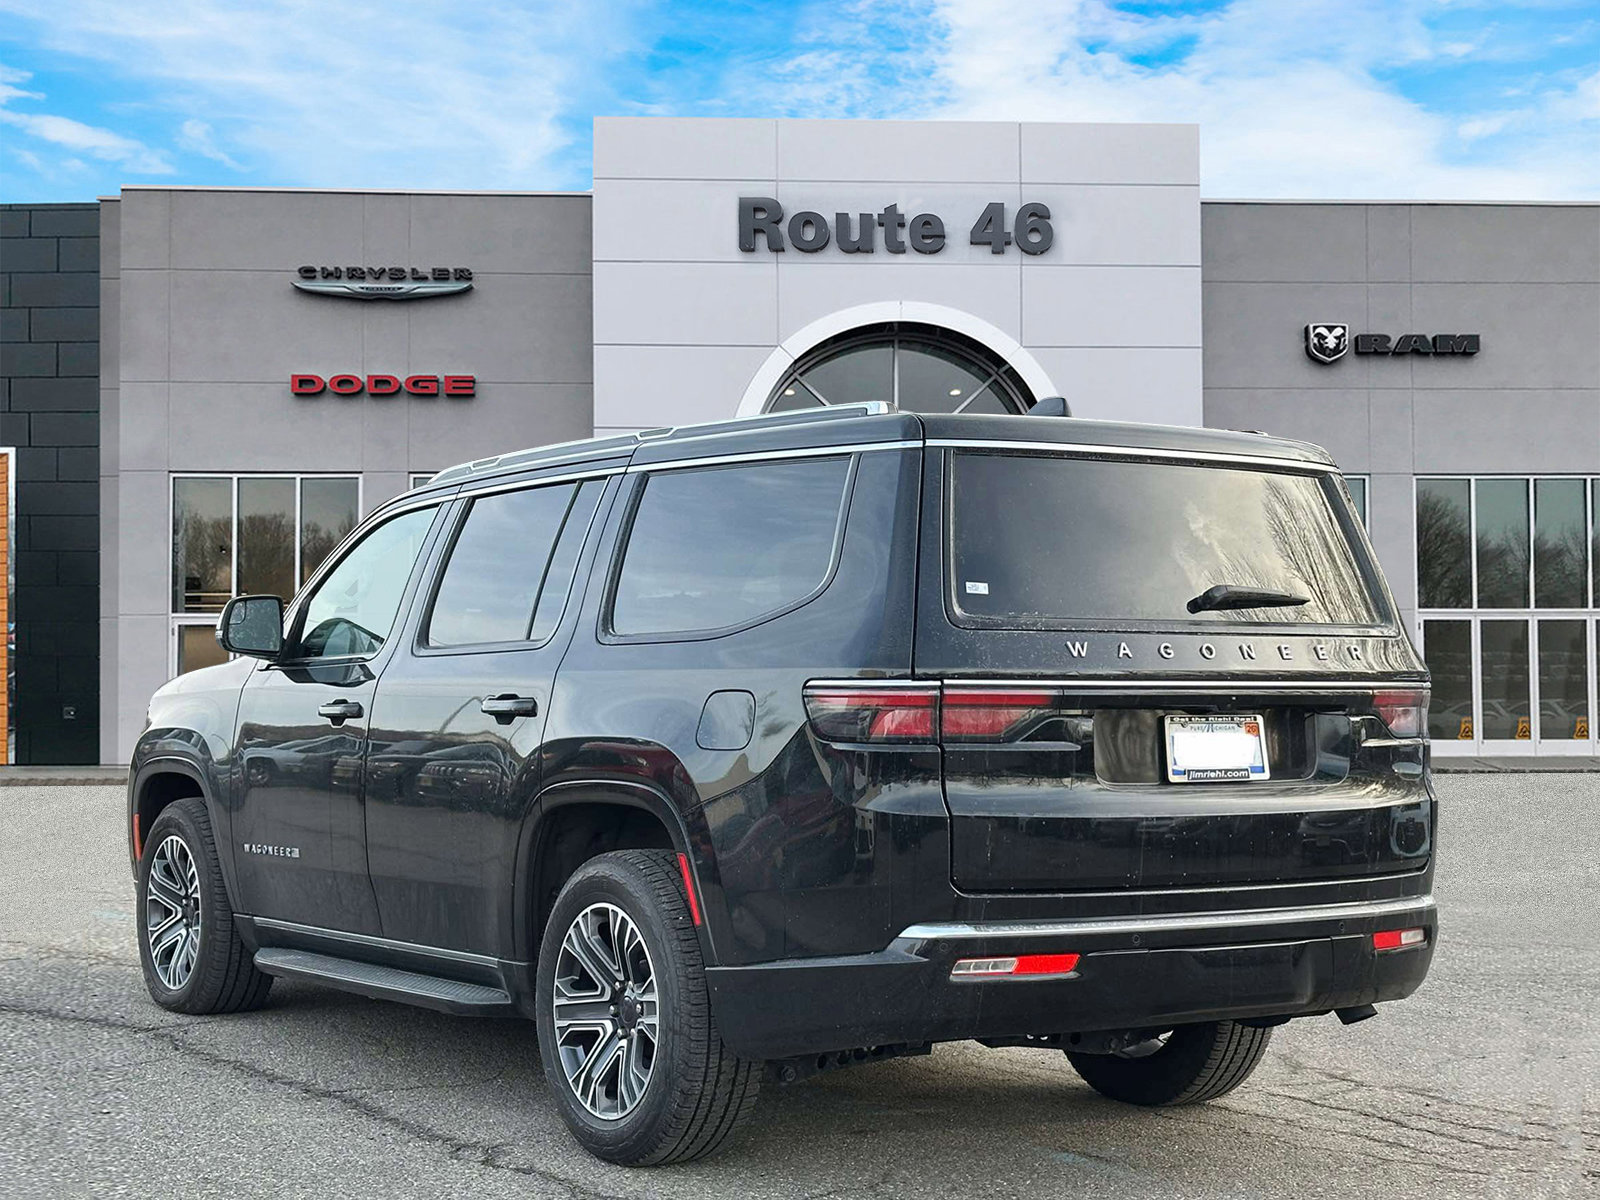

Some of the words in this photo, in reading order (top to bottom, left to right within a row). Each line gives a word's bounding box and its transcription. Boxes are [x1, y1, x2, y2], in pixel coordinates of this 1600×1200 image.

[738, 196, 946, 255] Route
[969, 202, 1054, 256] 46
[298, 265, 474, 280] CHRYSLER
[1354, 333, 1481, 355] RAM
[290, 374, 476, 397] DODGE
[1065, 641, 1362, 661] WAGONEER
[243, 843, 291, 857] WAGONEER
